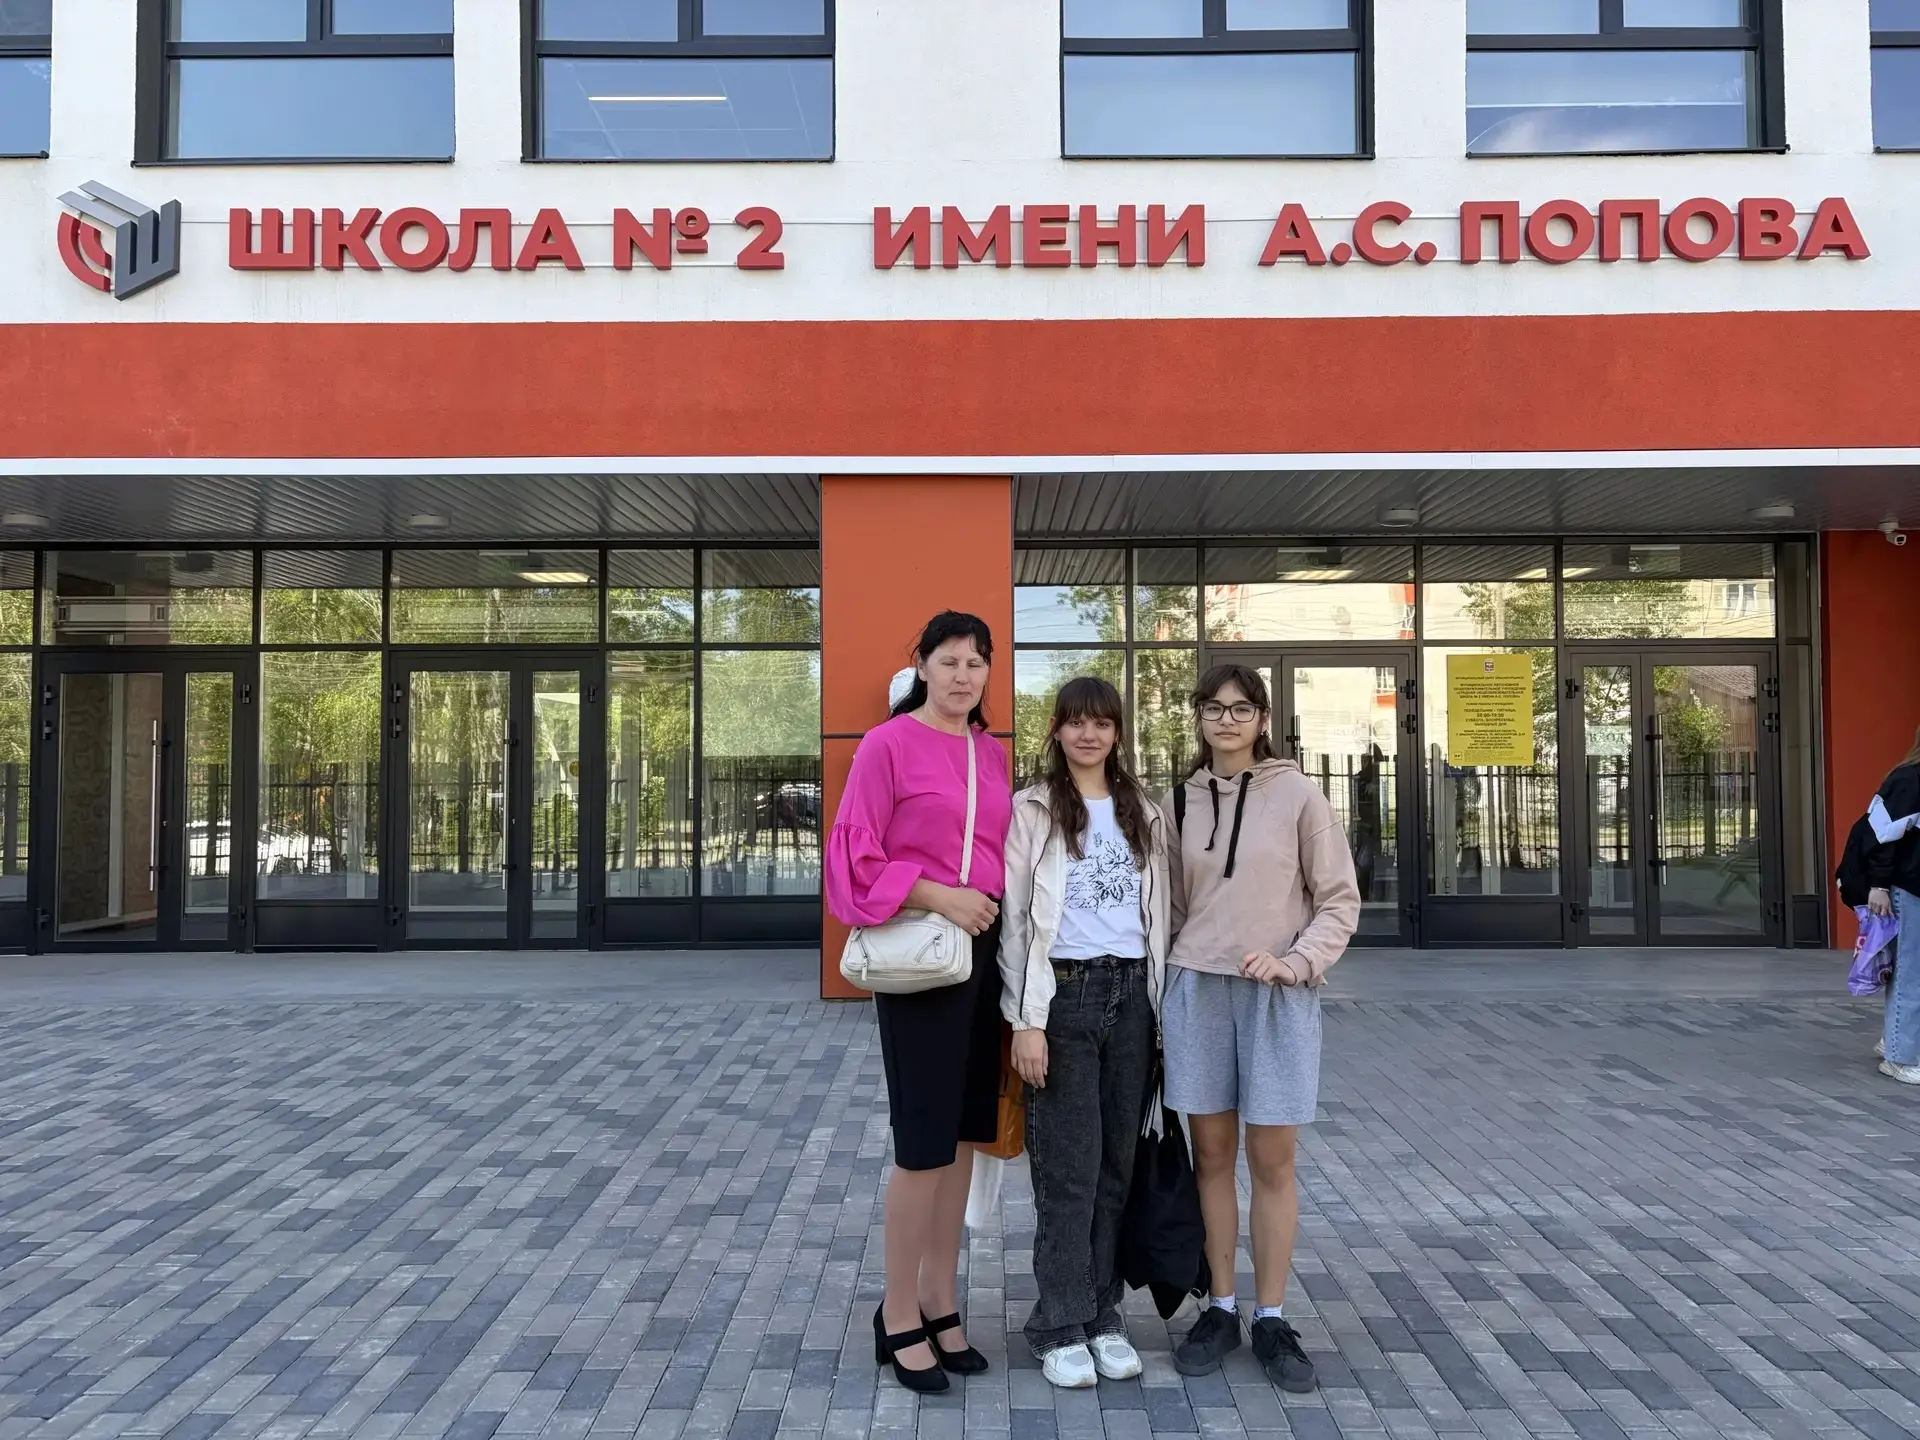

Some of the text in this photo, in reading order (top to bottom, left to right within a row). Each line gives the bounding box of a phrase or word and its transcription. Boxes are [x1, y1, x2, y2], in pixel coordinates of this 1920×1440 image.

[229, 197, 1870, 271] ШКОЛА № 2 ИМЕНИ А.С. ПОПОВА
